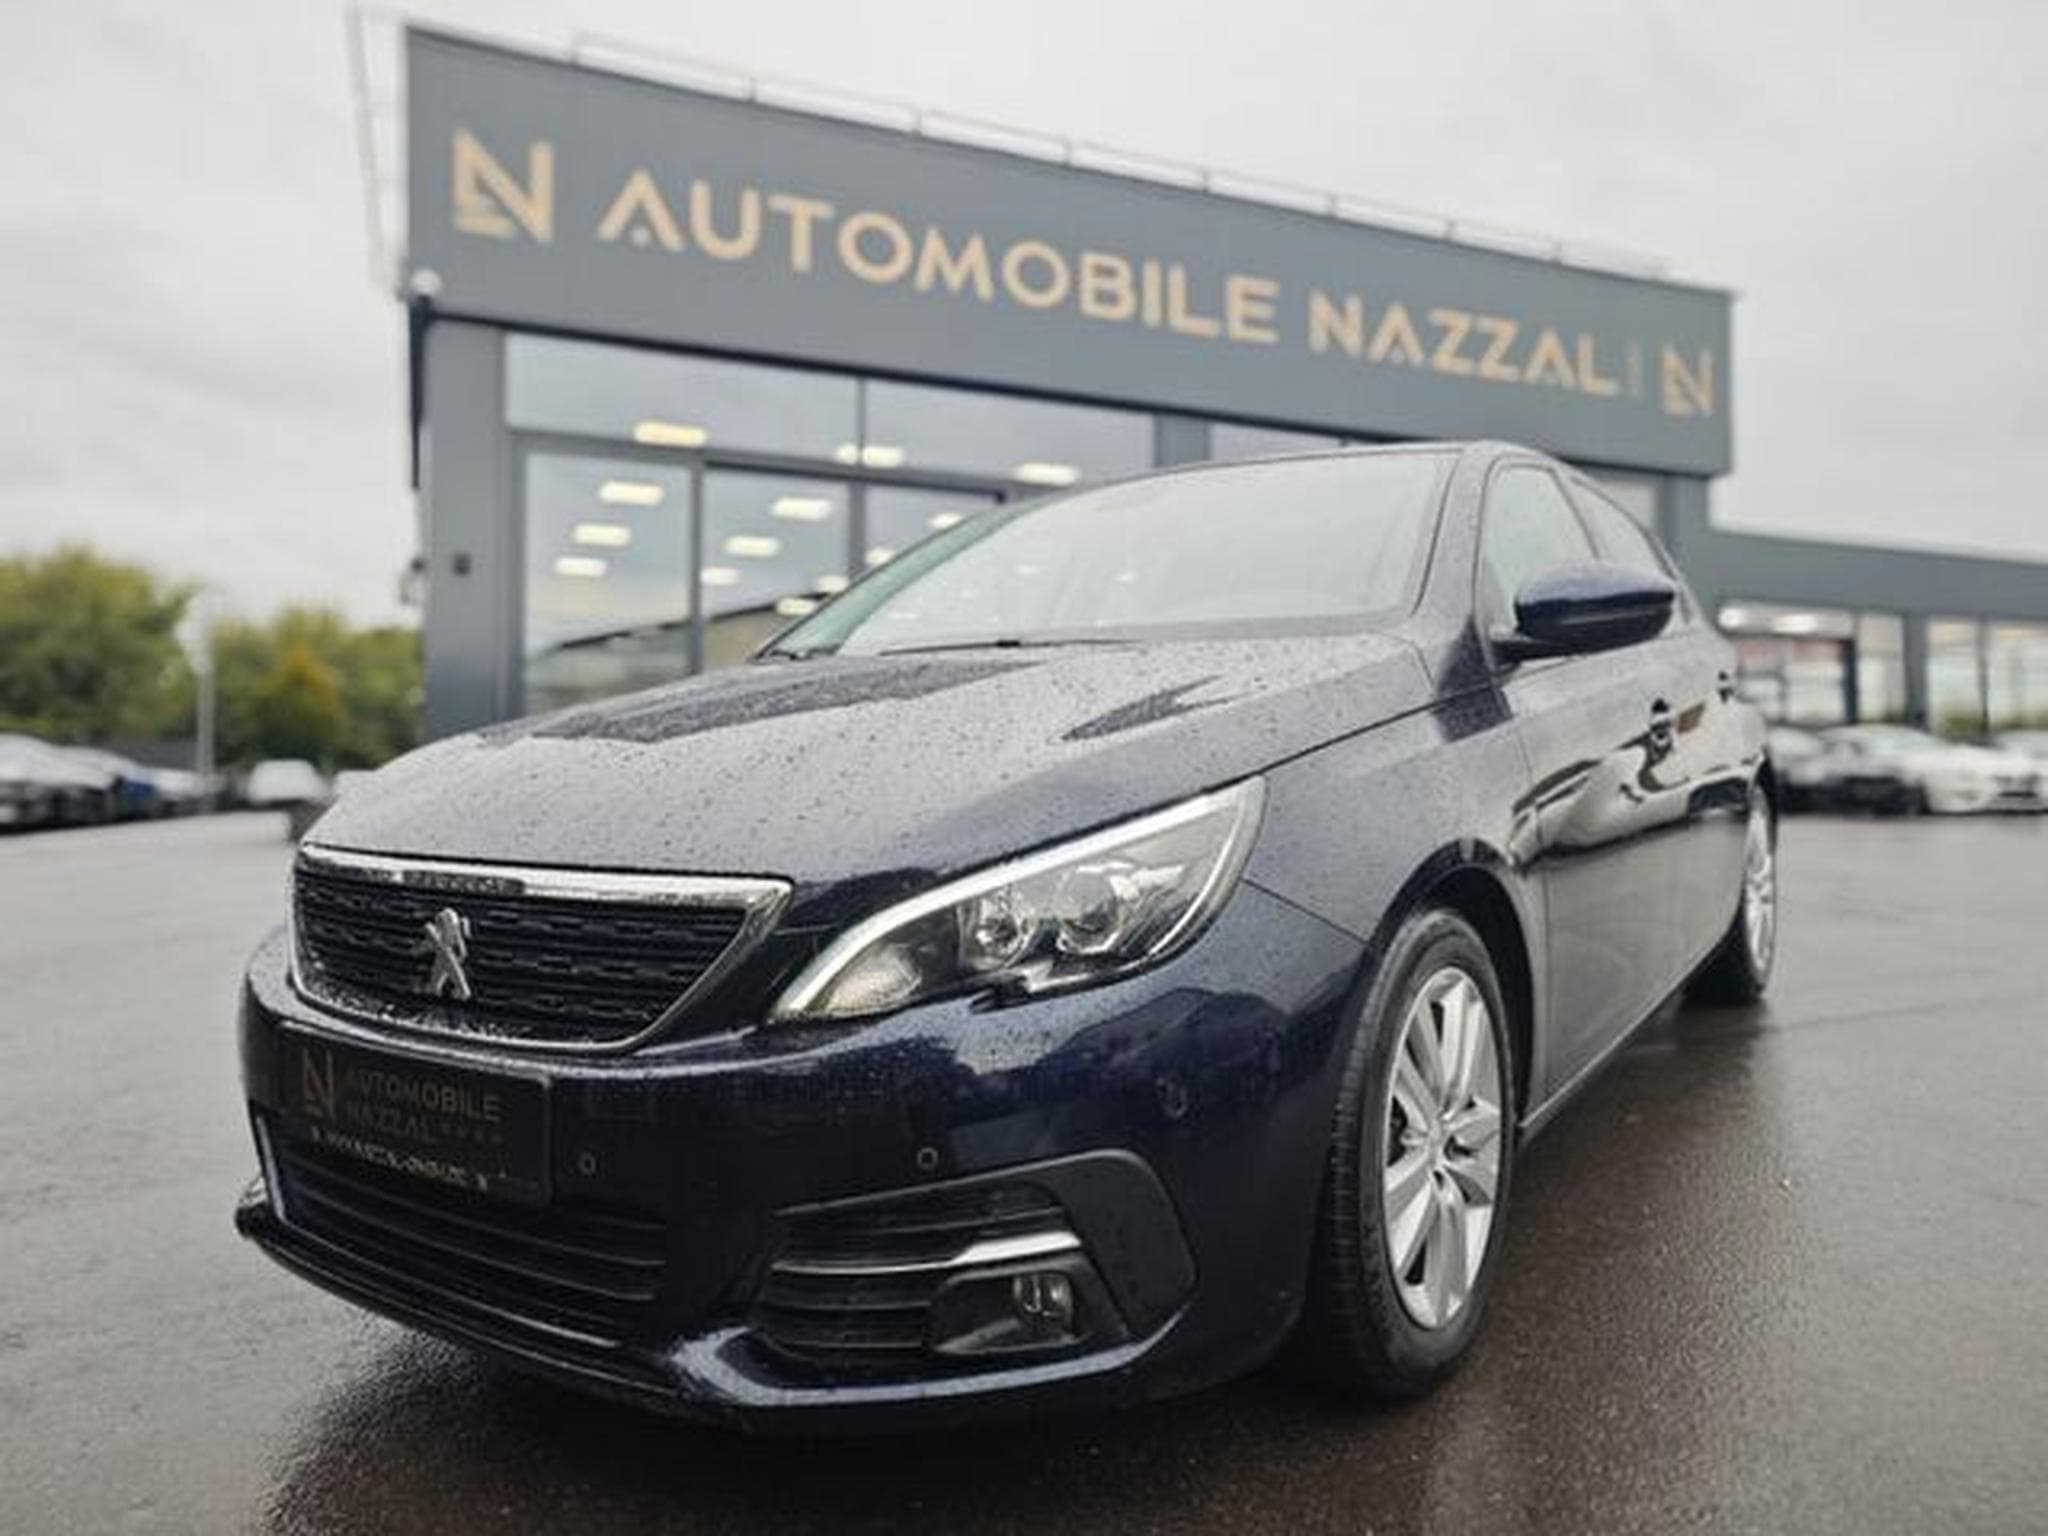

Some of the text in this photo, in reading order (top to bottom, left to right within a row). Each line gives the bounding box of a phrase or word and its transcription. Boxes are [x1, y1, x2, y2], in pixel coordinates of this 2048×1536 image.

[596, 168, 1280, 345] AUTOMOBILE
[1308, 290, 1617, 397] NAZZAL
[345, 1063, 502, 1125] AUTOMOBILE
